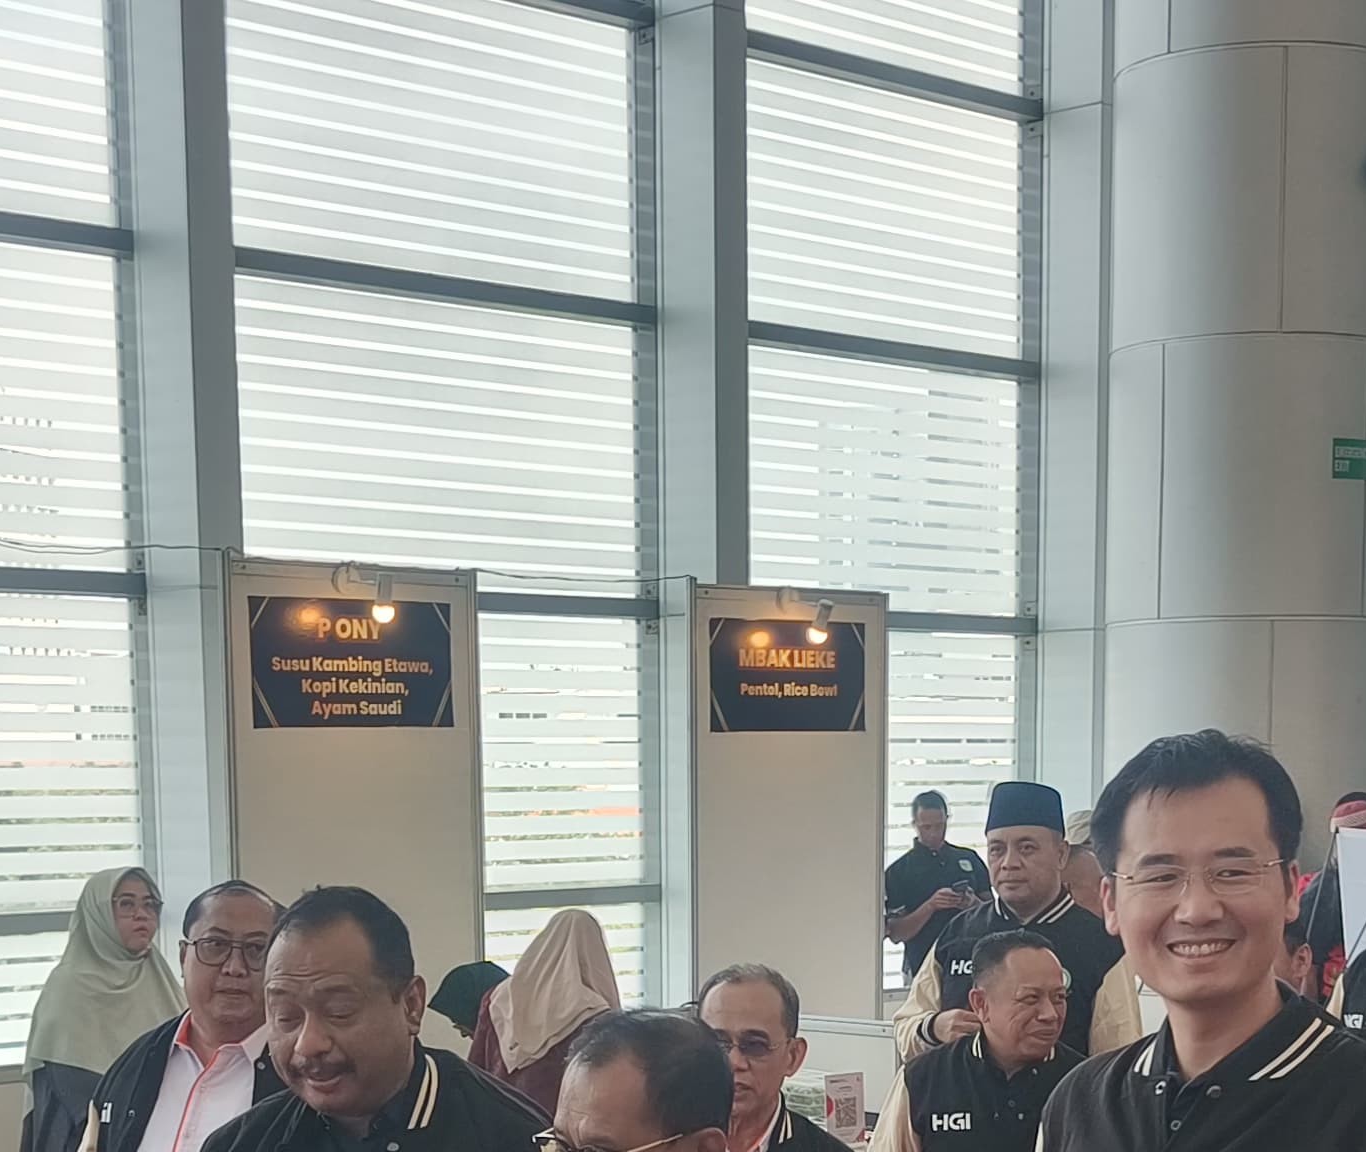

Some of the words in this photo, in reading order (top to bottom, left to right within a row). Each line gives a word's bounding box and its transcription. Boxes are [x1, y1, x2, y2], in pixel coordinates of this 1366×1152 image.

[271, 656, 310, 671] Susu
[311, 656, 383, 676] Kambing
[384, 657, 434, 675] Etawa,
[738, 648, 790, 668] MBAK
[301, 677, 336, 697] Kopi
[338, 678, 410, 696] Kekinian,
[740, 682, 783, 699] Pentol,
[784, 682, 809, 697] Rice
[311, 701, 357, 720] Ayam
[359, 700, 402, 715] Saudi
[950, 959, 973, 975] HG
[931, 1112, 971, 1131] HGI
